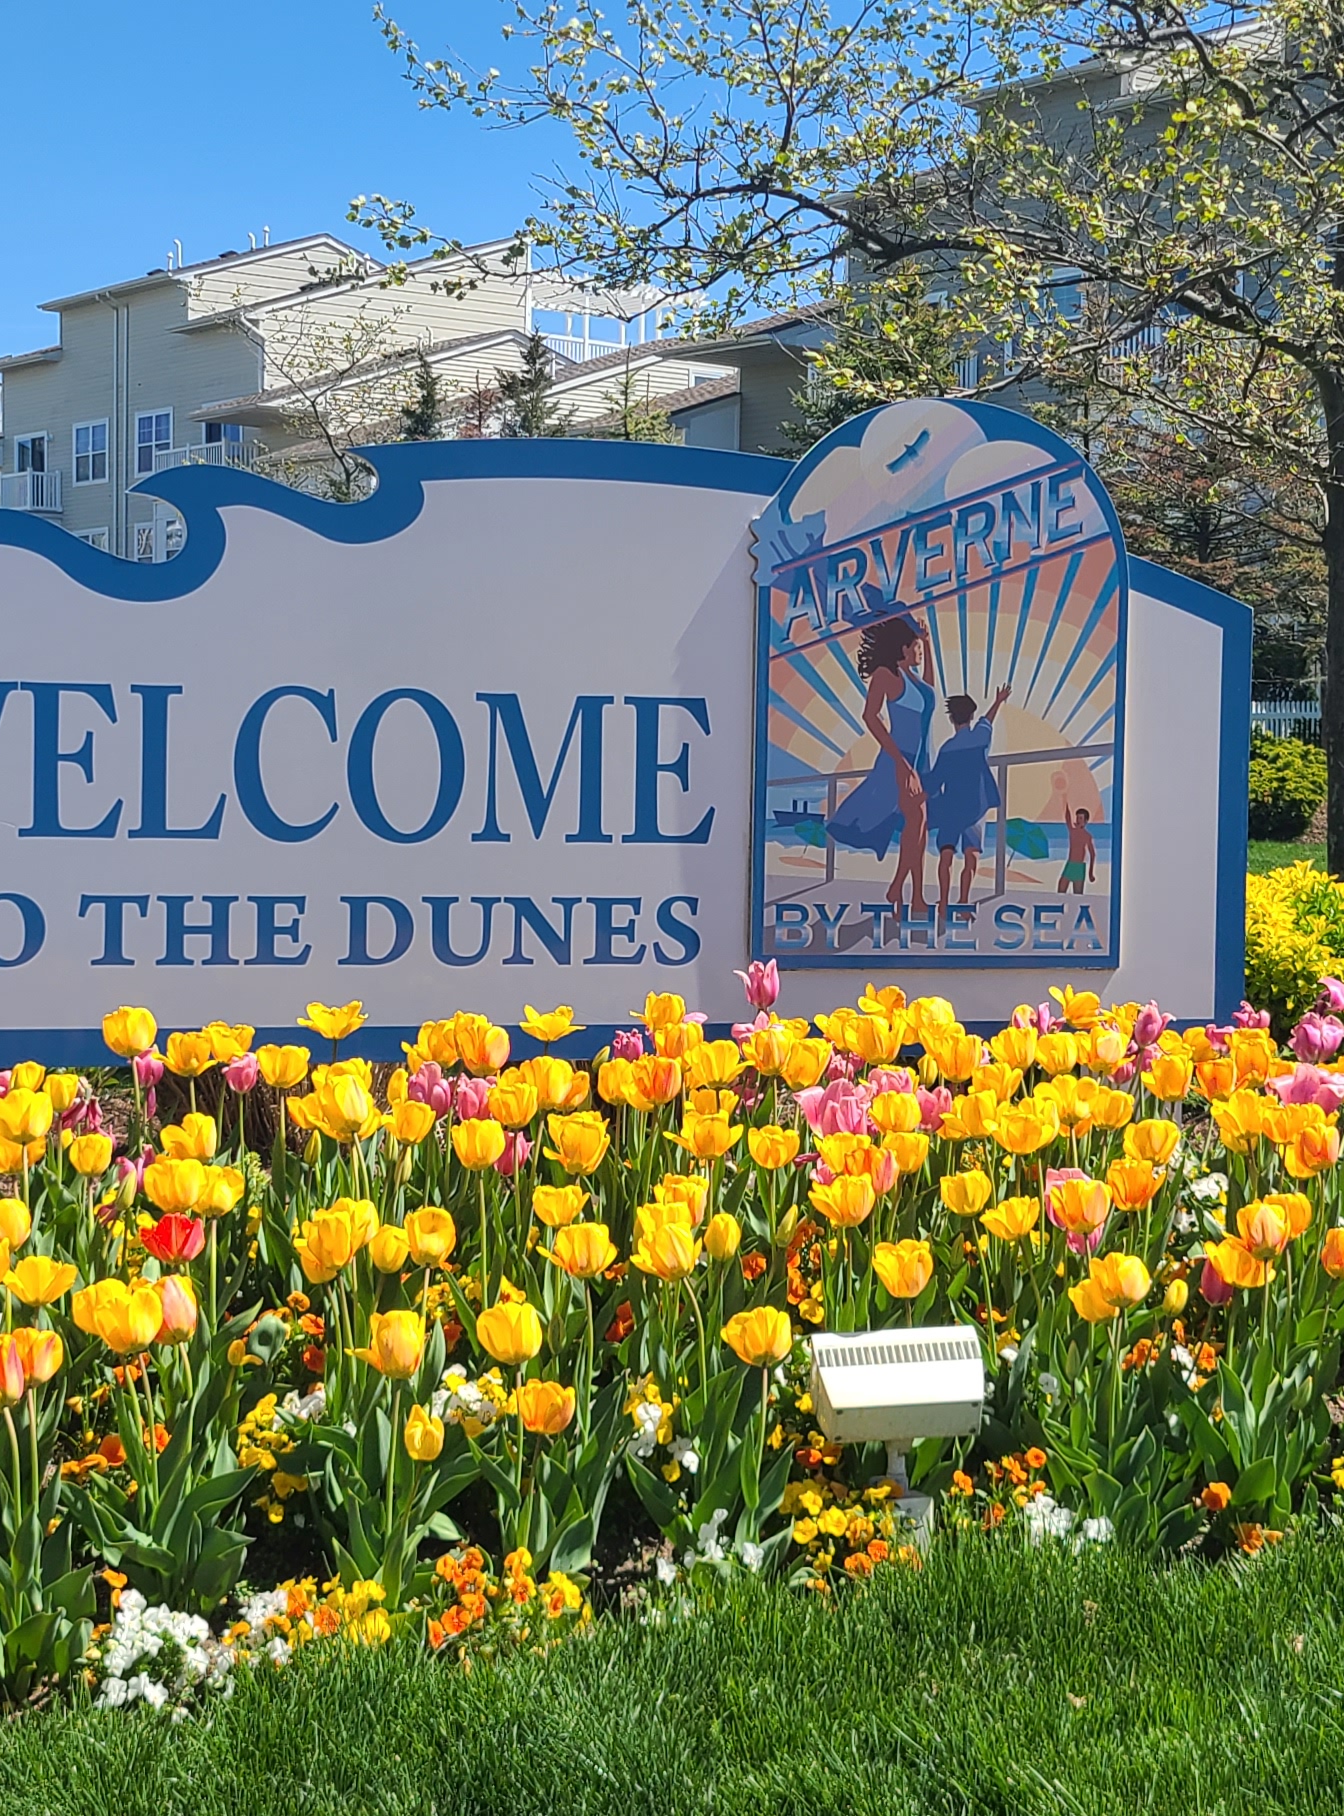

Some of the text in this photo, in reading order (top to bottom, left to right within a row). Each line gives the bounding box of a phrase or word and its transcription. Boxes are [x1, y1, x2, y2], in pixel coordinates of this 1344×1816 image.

[782, 466, 1085, 643] ARVERNE
[78, 893, 314, 968] THE
[338, 895, 702, 968] DUNES
[773, 902, 1103, 951] BY THE SEA
